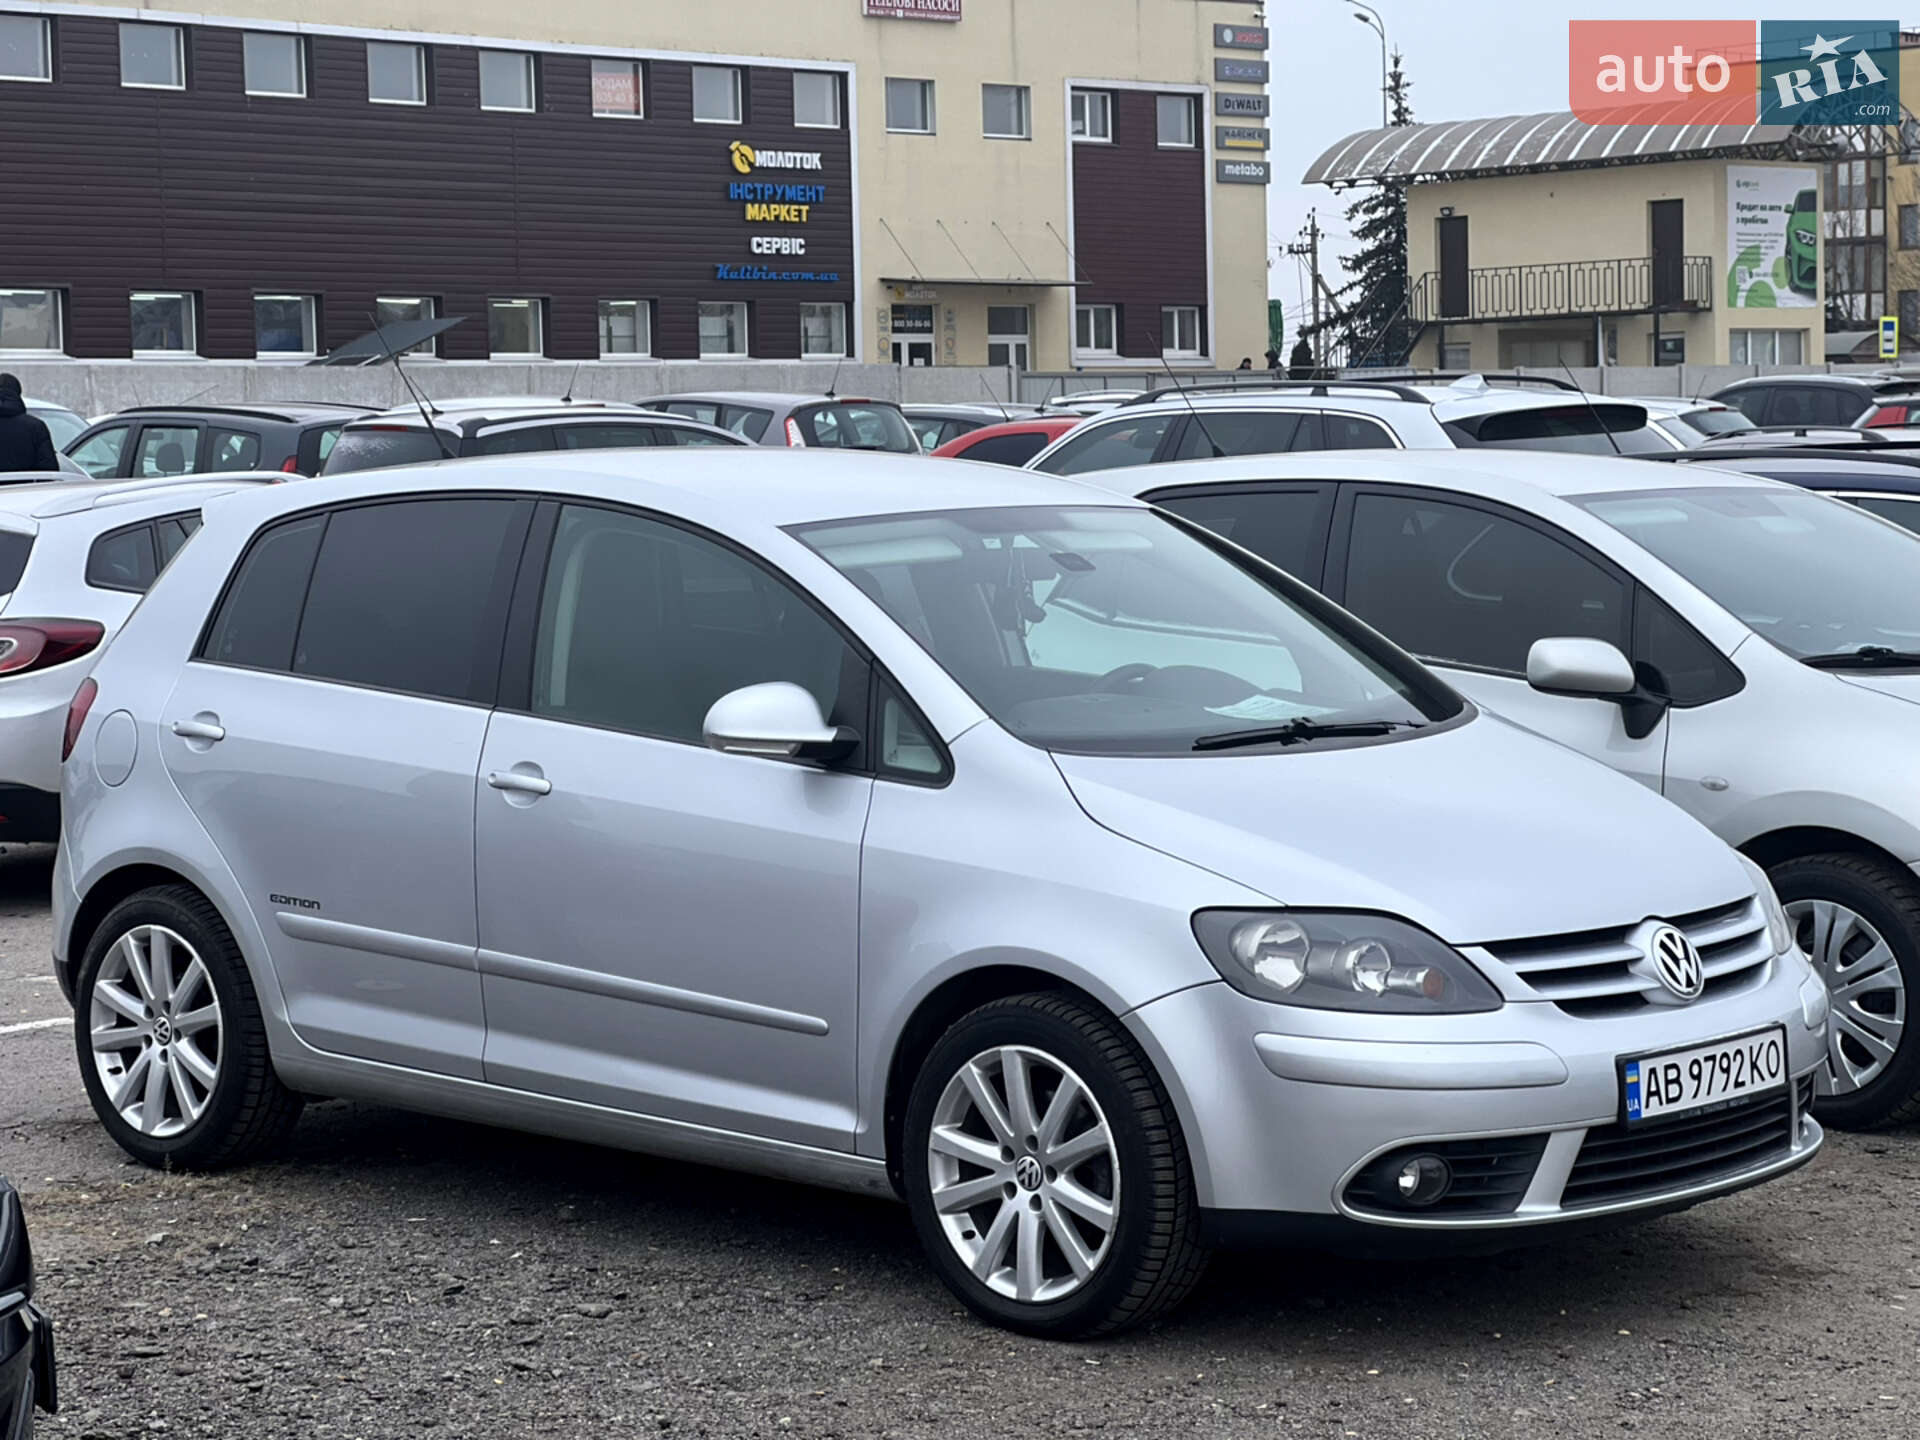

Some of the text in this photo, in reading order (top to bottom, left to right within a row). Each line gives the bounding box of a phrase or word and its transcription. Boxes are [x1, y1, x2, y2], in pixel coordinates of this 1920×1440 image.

[754, 150, 822, 170] МОЛОТОК
[1224, 163, 1264, 176] metabo
[729, 182, 826, 203] ІНСТРУМЕНТ
[745, 203, 810, 223] МАРКЕТ
[750, 236, 806, 256] СЕРВІС
[1644, 1062, 1684, 1110] AB
[1688, 1048, 1747, 1100] 9792
[1749, 1039, 1781, 1086] KO
[1627, 1098, 1641, 1111] UA
